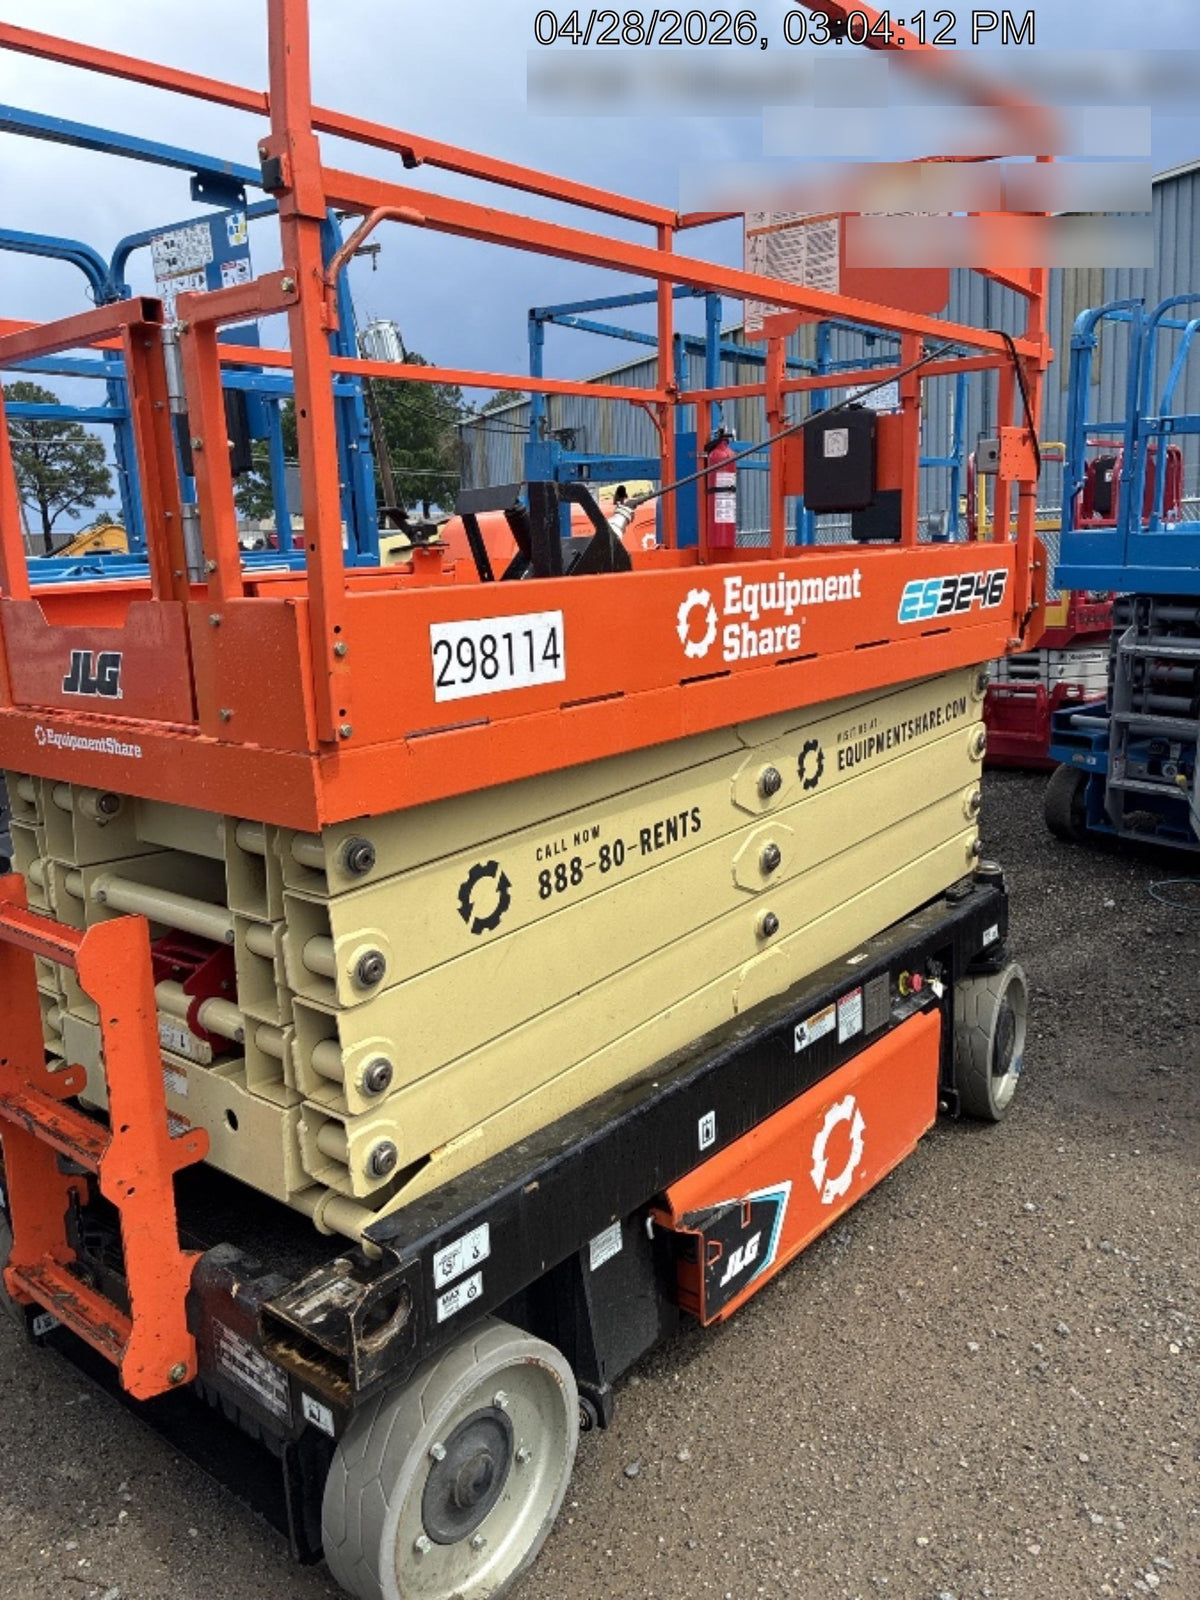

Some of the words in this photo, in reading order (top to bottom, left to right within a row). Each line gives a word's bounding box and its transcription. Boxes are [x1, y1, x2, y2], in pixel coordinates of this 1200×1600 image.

[723, 569, 861, 621] Equipment
[898, 569, 1009, 625] ES3246
[433, 626, 561, 688] 298114
[722, 622, 801, 663] Share
[62, 650, 123, 699] JLG
[45, 728, 143, 759] EquipmentShare
[837, 696, 968, 771] EQUIPMENTSHARE.COM
[536, 837, 568, 861] CALL
[574, 825, 602, 847] NOW
[538, 807, 702, 900] 888-80-RENTS
[720, 1231, 762, 1288] JLG
